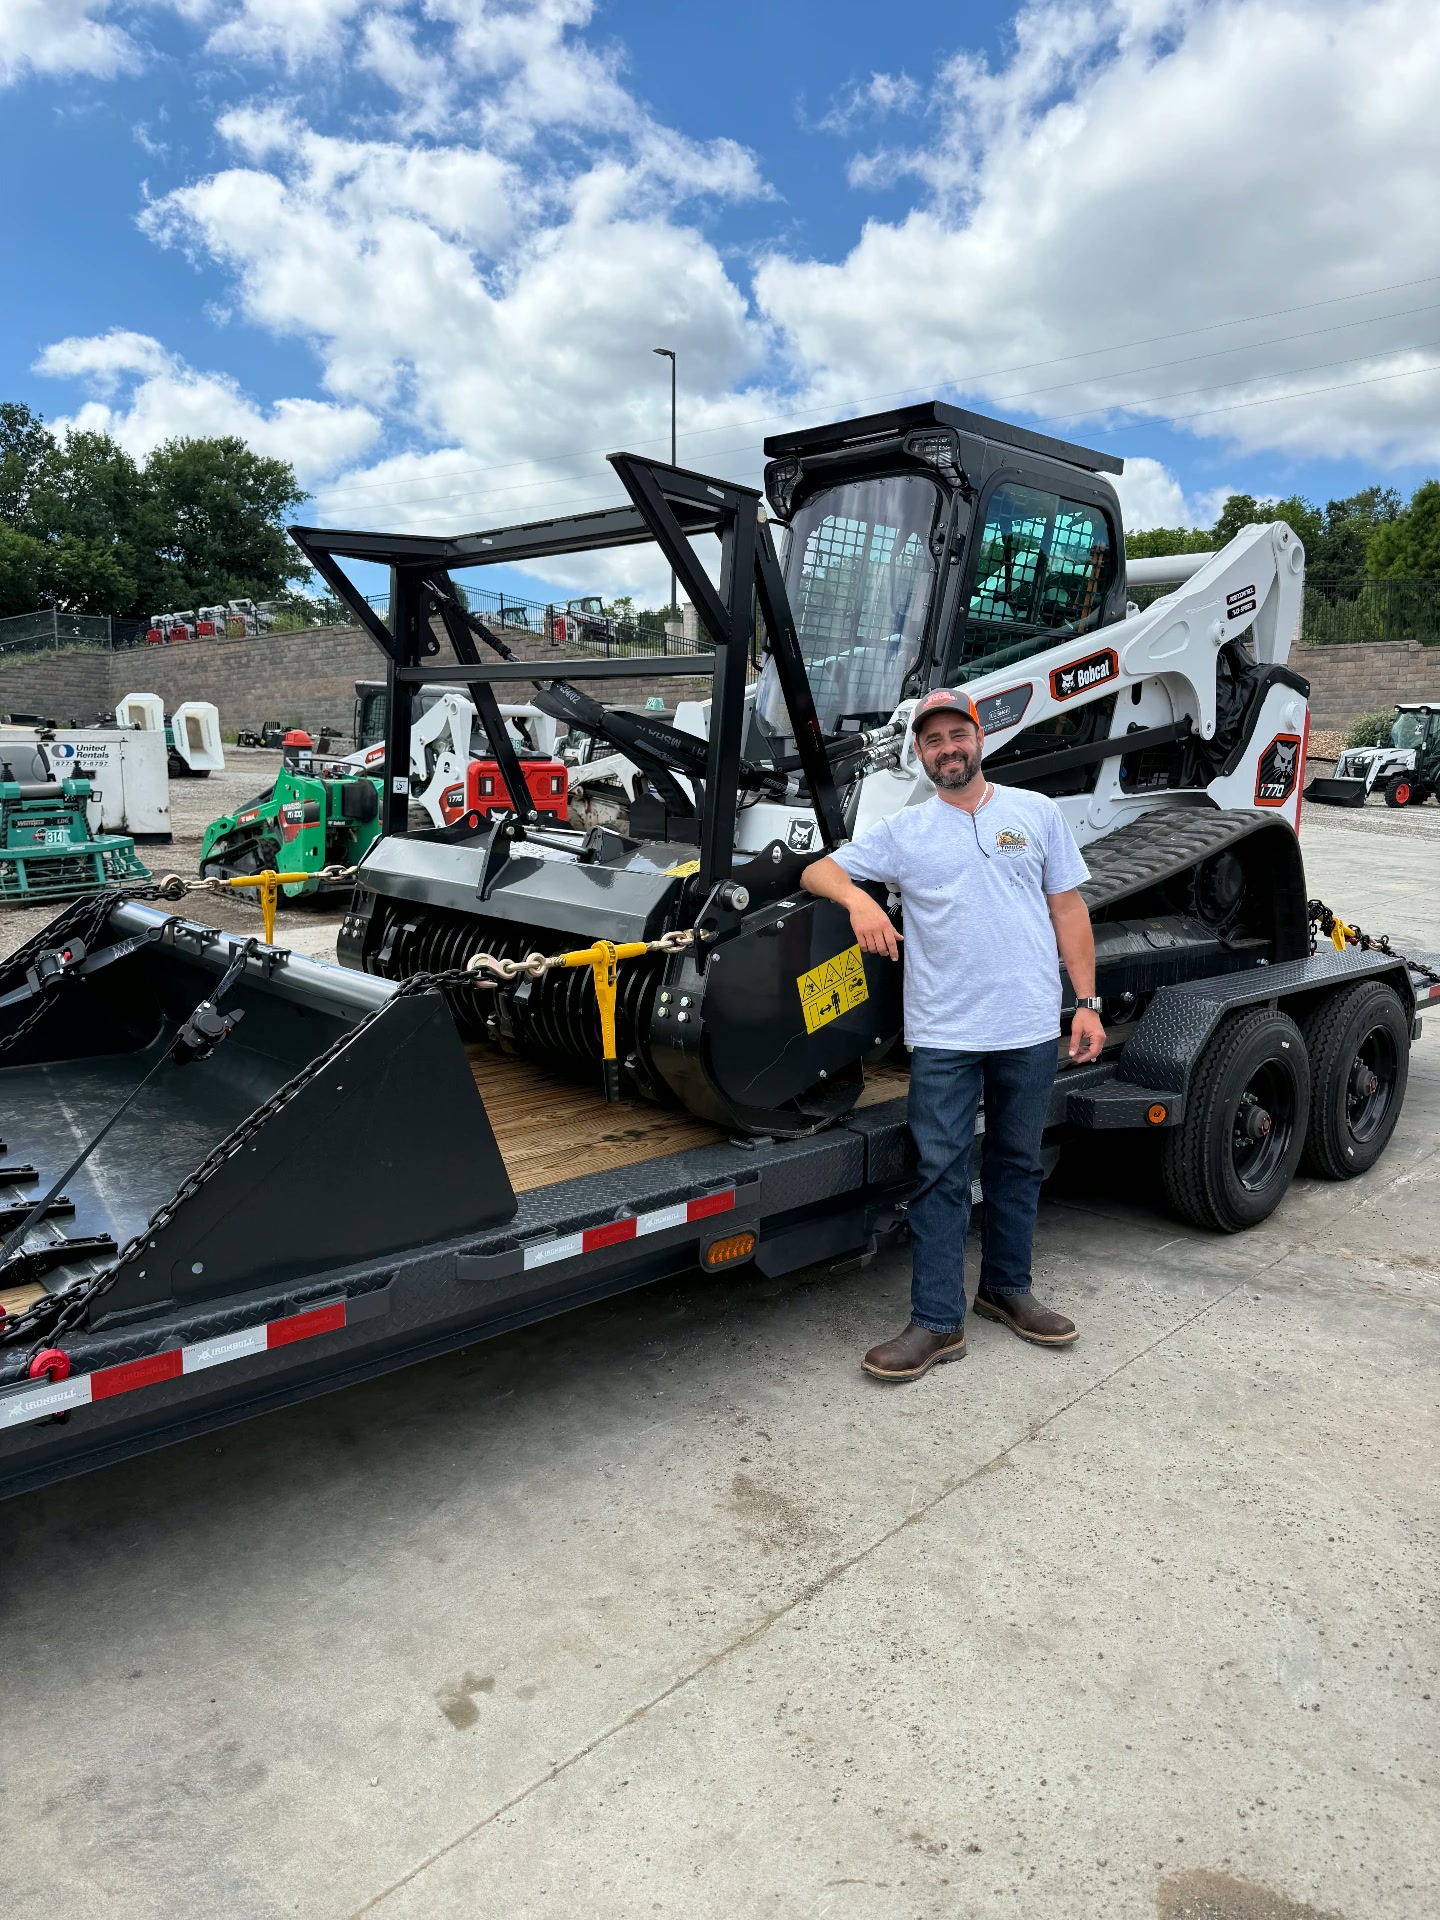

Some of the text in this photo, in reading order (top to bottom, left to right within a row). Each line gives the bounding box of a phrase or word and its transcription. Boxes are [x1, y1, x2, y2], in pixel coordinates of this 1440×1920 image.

[1077, 659, 1110, 688] Bobcat
[76, 744, 107, 752] United
[76, 751, 110, 759] Rentals
[1259, 783, 1285, 797] T770
[47, 831, 63, 843] 314
[211, 1336, 255, 1356] IRONBULL
[25, 1388, 77, 1411] IRONBULL
